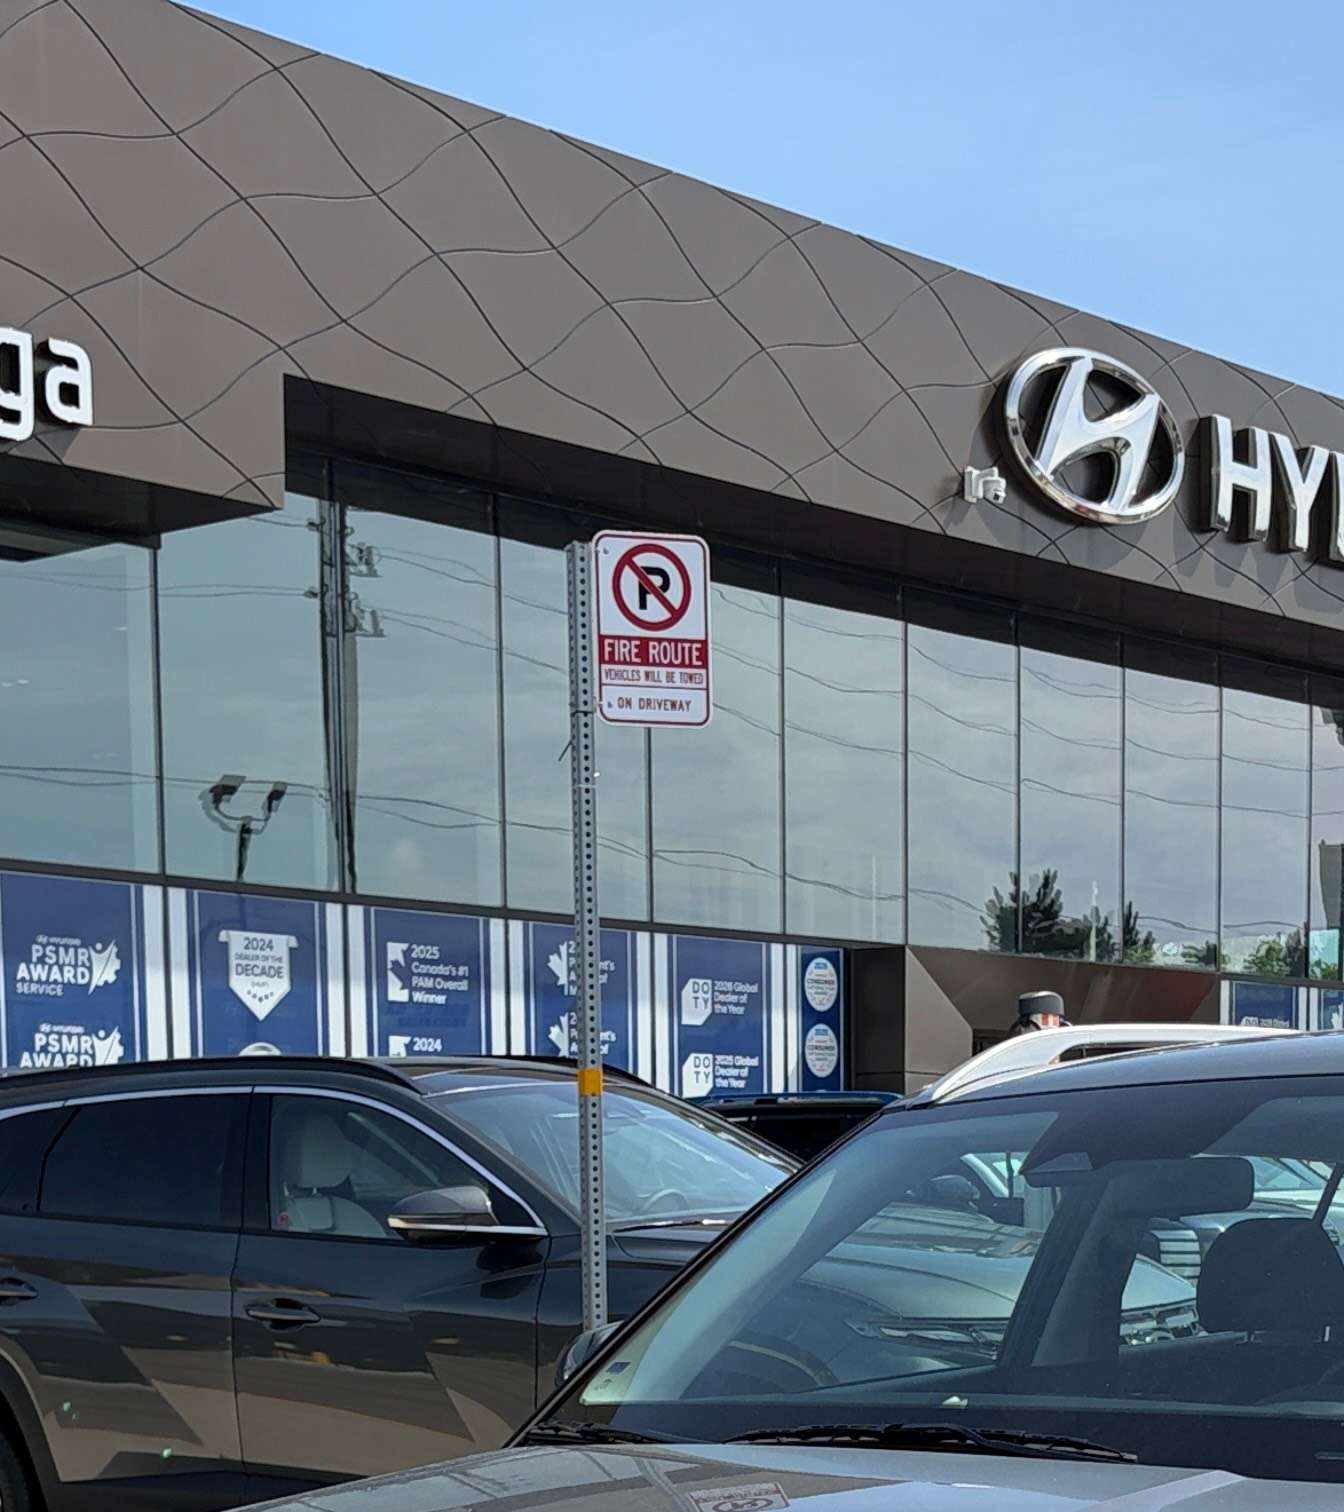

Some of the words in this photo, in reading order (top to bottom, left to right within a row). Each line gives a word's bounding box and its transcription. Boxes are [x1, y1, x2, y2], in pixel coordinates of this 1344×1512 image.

[604, 639, 641, 663] FIRE
[648, 641, 702, 666] ROUTE
[604, 668, 641, 682] VEHICLES
[644, 670, 662, 683] WILL
[665, 671, 675, 683] BE
[678, 672, 704, 685] TOWED
[617, 697, 632, 710] ON
[638, 699, 692, 712] DRIVEWAY
[243, 937, 274, 952] 2024
[410, 944, 441, 960] 2025
[31, 944, 90, 967] PSMR
[16, 962, 91, 985] AWARD
[235, 963, 285, 979] DECADE
[411, 961, 457, 976] Canada's
[457, 965, 469, 977] #1
[16, 981, 64, 997] SERVICE
[411, 976, 434, 989] PAM
[434, 978, 469, 991] Overall
[733, 982, 759, 993] Global
[411, 990, 447, 1005] Winner
[714, 991, 739, 1003] Dealer
[739, 993, 748, 1004] of
[714, 1003, 727, 1014] the
[727, 1004, 745, 1015] Year
[34, 1032, 93, 1054] PSMR
[412, 1037, 443, 1052] 2024
[734, 1055, 759, 1067] Global
[715, 1065, 739, 1077] Dealer
[740, 1066, 749, 1077] of
[715, 1077, 728, 1088] the
[728, 1078, 746, 1089] Year
